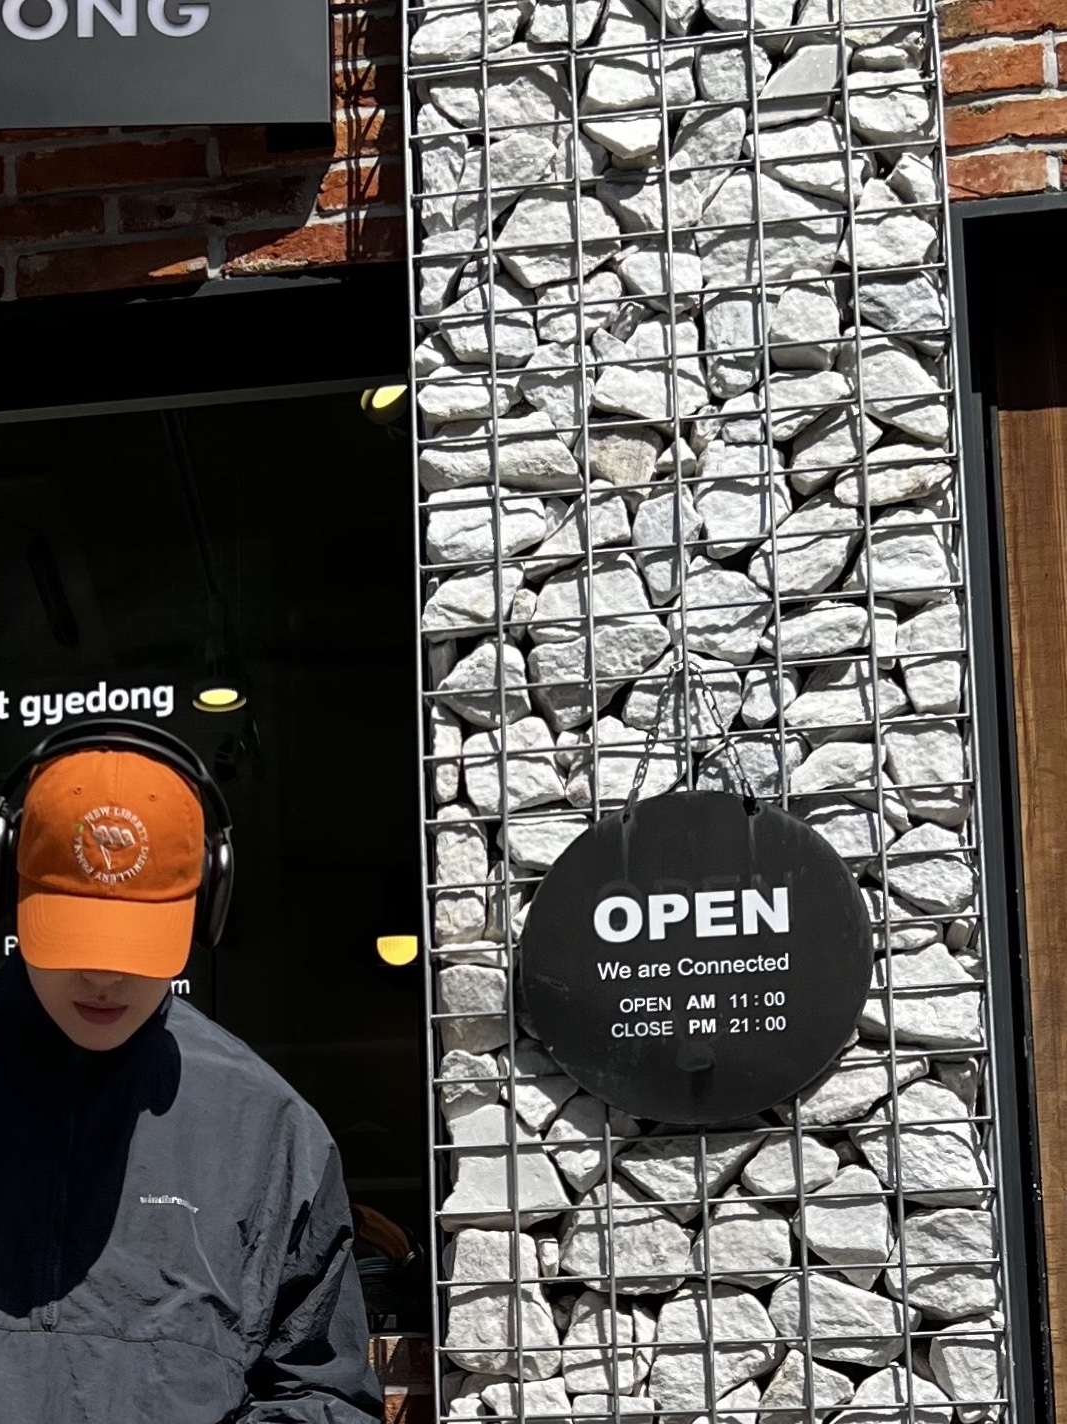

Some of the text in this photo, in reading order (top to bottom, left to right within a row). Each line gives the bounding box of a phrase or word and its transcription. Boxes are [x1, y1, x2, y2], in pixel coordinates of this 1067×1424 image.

[19, 681, 174, 728] gyedong
[593, 886, 790, 943] OPEN
[596, 952, 789, 981] We are Connected
[619, 996, 672, 1014] OPEN
[686, 993, 716, 1010] AM
[611, 1020, 674, 1038] CLOSE
[688, 1018, 717, 1035] PM
